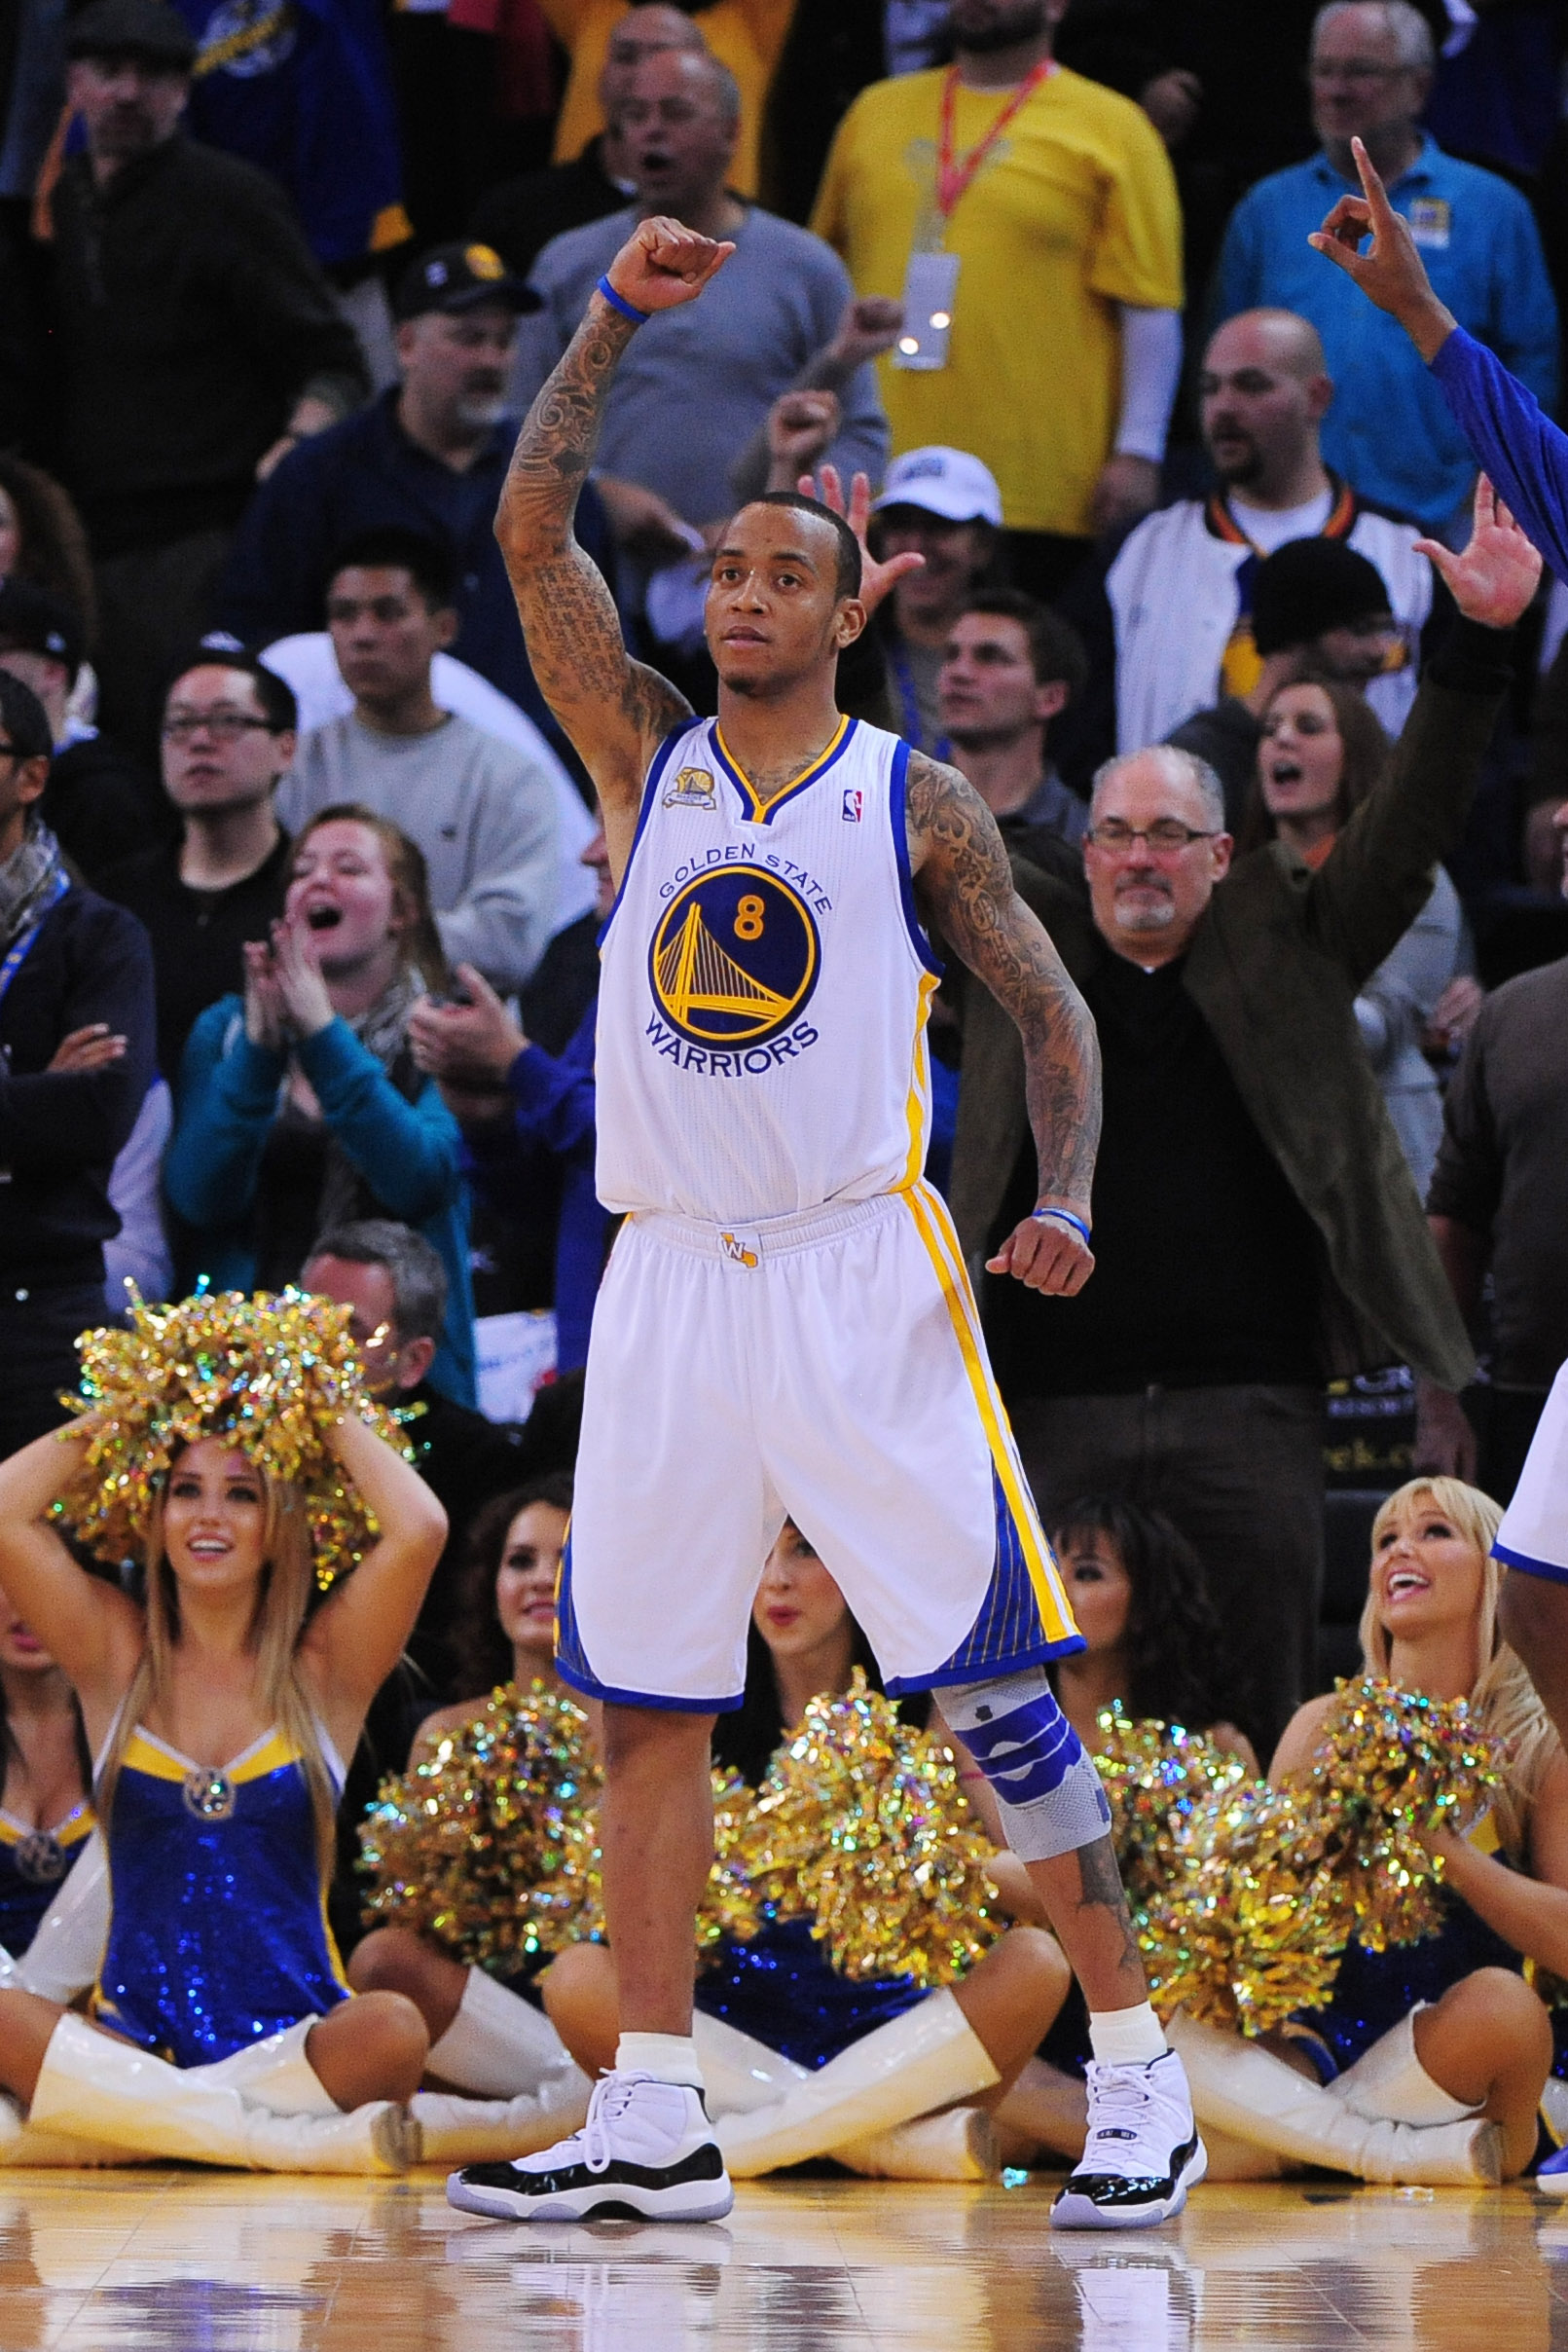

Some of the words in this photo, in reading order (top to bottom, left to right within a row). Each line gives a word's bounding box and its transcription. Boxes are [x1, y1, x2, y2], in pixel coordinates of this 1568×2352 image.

[659, 843, 755, 899] GOLDEN
[765, 854, 833, 914] STATE
[733, 895, 765, 940] 8
[645, 1012, 820, 1078] WARRIORS
[721, 1240, 747, 1260] W
